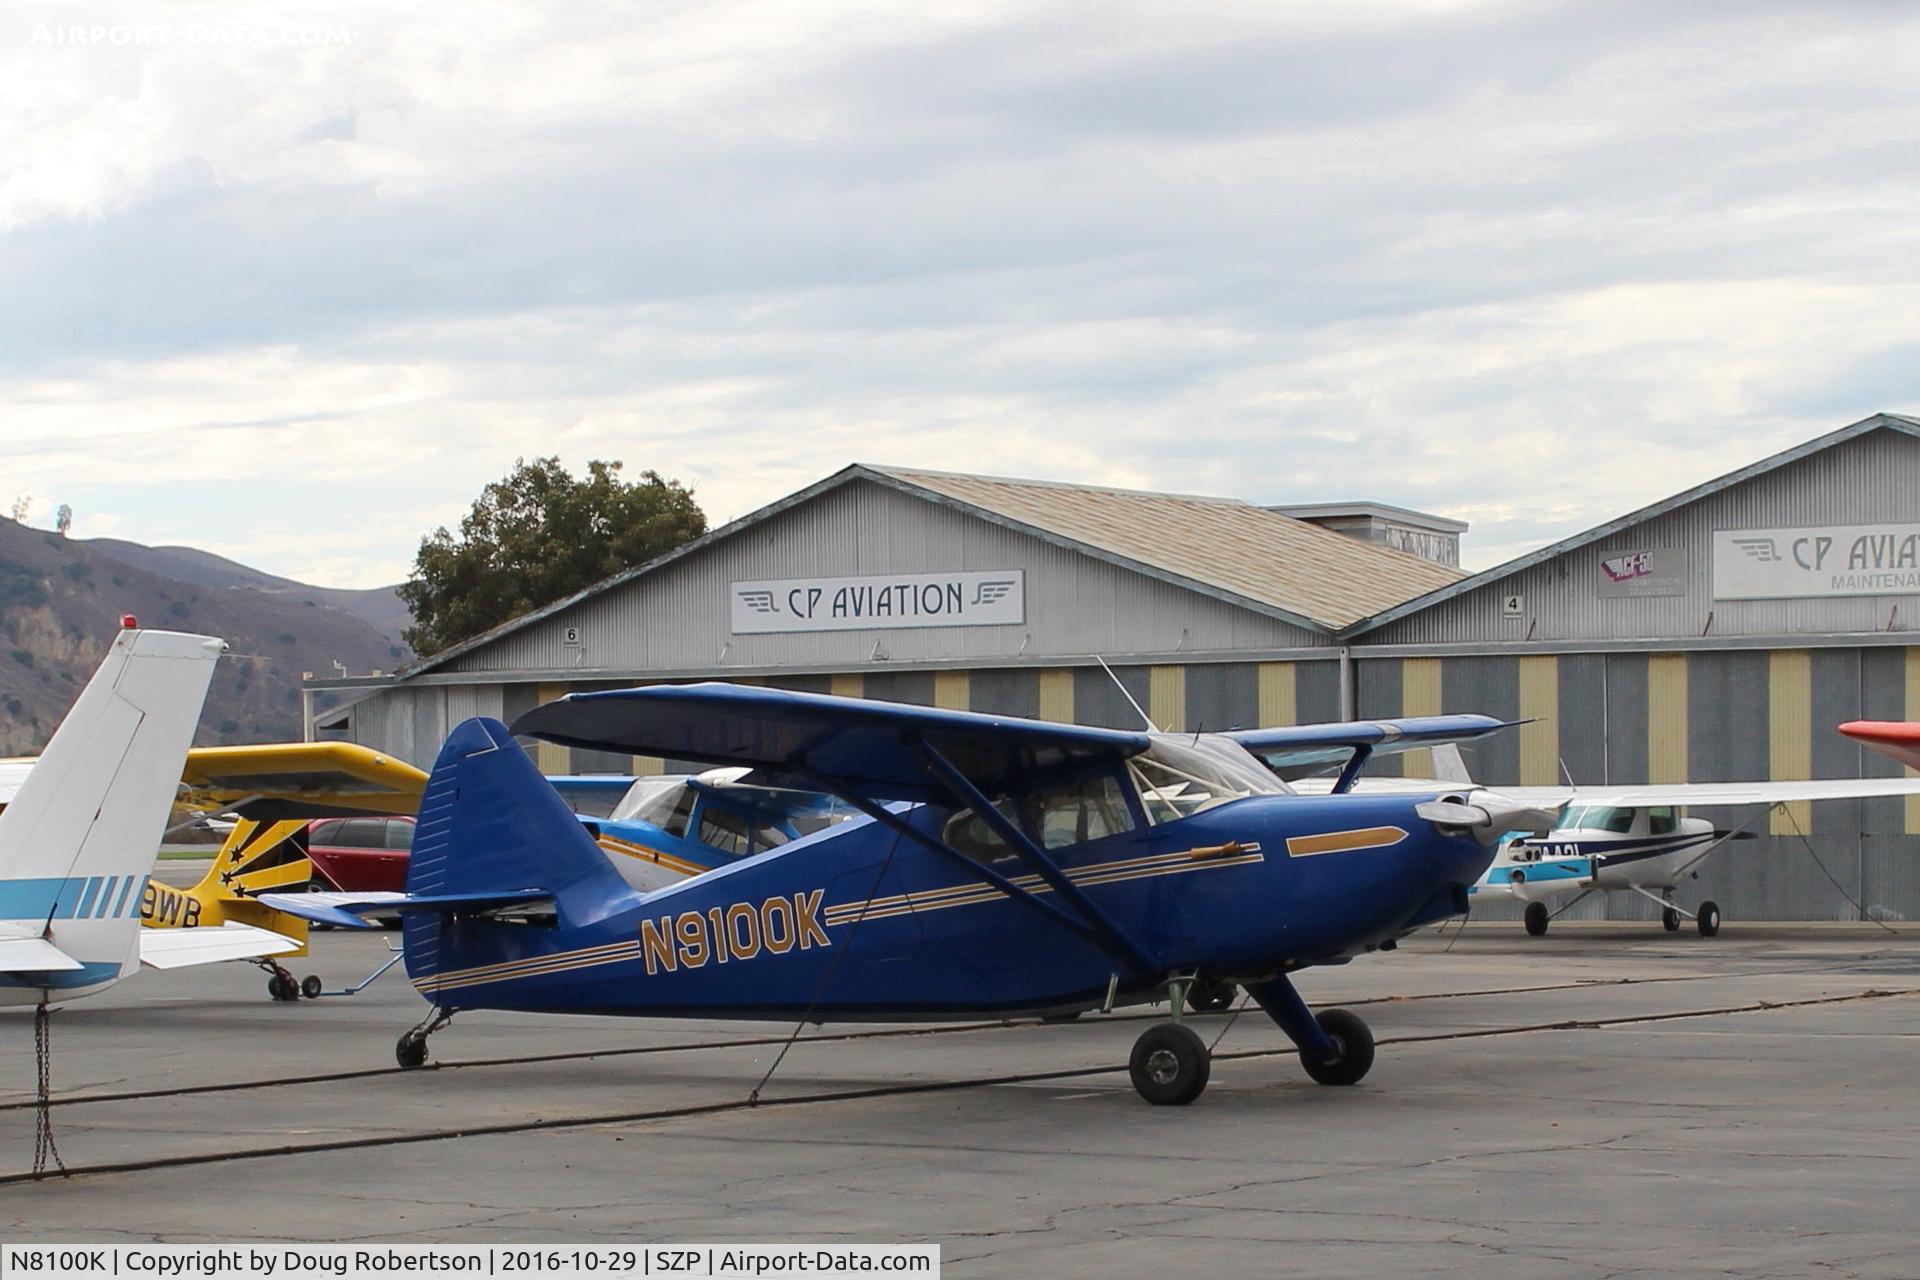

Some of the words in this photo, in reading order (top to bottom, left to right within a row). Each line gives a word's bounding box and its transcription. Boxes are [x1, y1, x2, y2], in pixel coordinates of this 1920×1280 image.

[1793, 537, 1833, 571] CP
[1848, 534, 1920, 570] AVIA
[1832, 573, 1920, 590] MAINTENA
[788, 588, 822, 619] CP
[832, 583, 963, 618] AVIATION
[1508, 597, 1518, 610] 4
[568, 628, 576, 640] 6
[641, 888, 831, 975] N9100K
